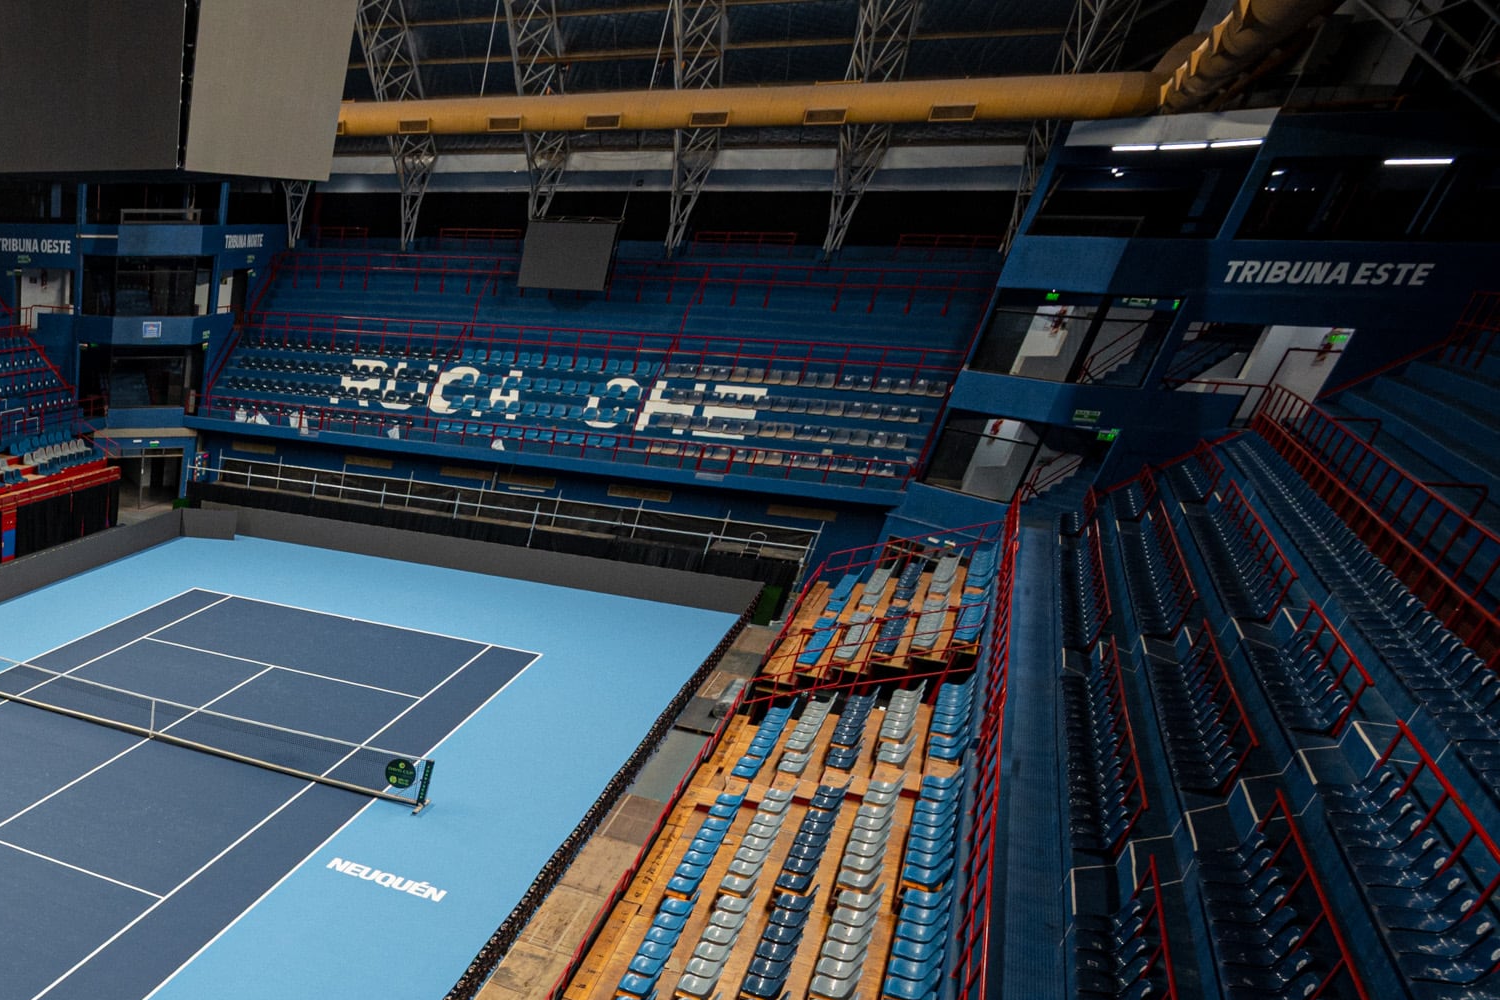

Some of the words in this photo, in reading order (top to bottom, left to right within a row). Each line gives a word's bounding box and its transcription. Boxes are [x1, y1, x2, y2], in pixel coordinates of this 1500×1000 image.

[40, 239, 71, 254] OESTE
[225, 234, 247, 248] TRIBUNA
[247, 234, 264, 248] NORTE
[1224, 260, 1349, 285] TRIBUNA
[1351, 263, 1436, 286] ESTE
[326, 857, 447, 902] NEUQUÉN
